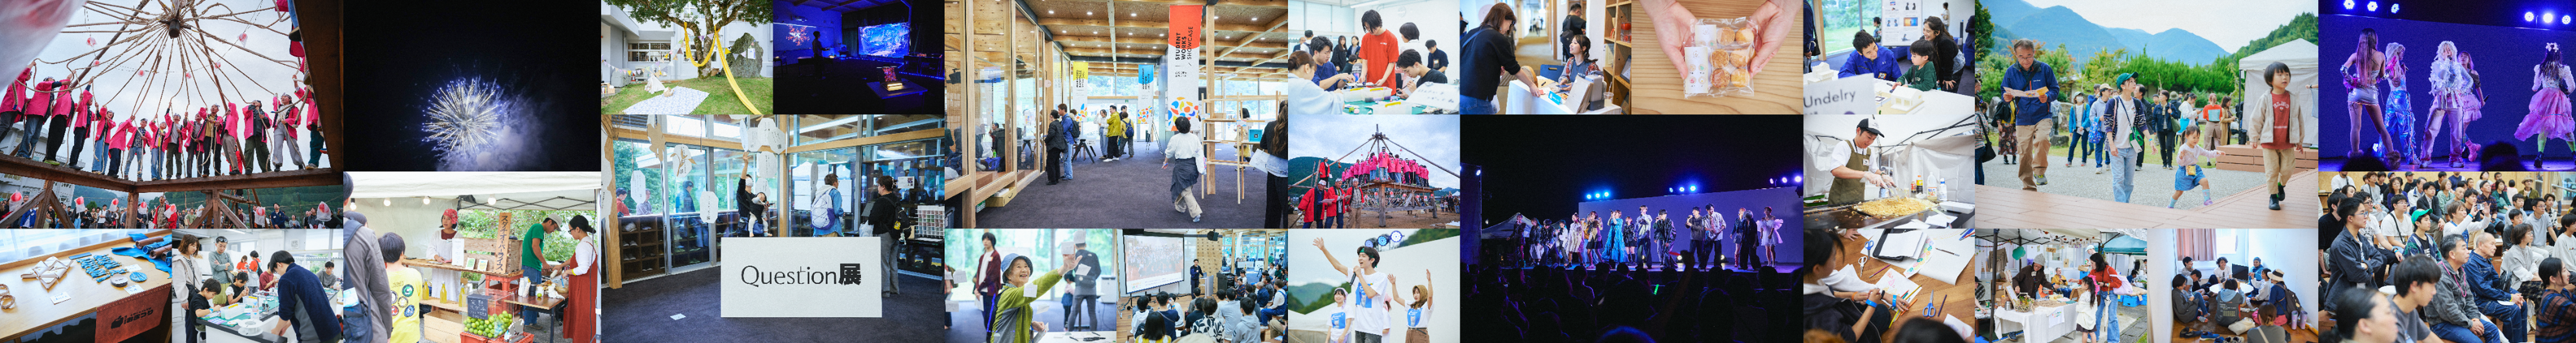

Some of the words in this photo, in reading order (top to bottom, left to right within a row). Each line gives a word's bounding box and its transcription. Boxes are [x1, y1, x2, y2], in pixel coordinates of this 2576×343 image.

[1803, 89, 1856, 108] Undelry
[496, 215, 509, 270] スダチオーバーライス
